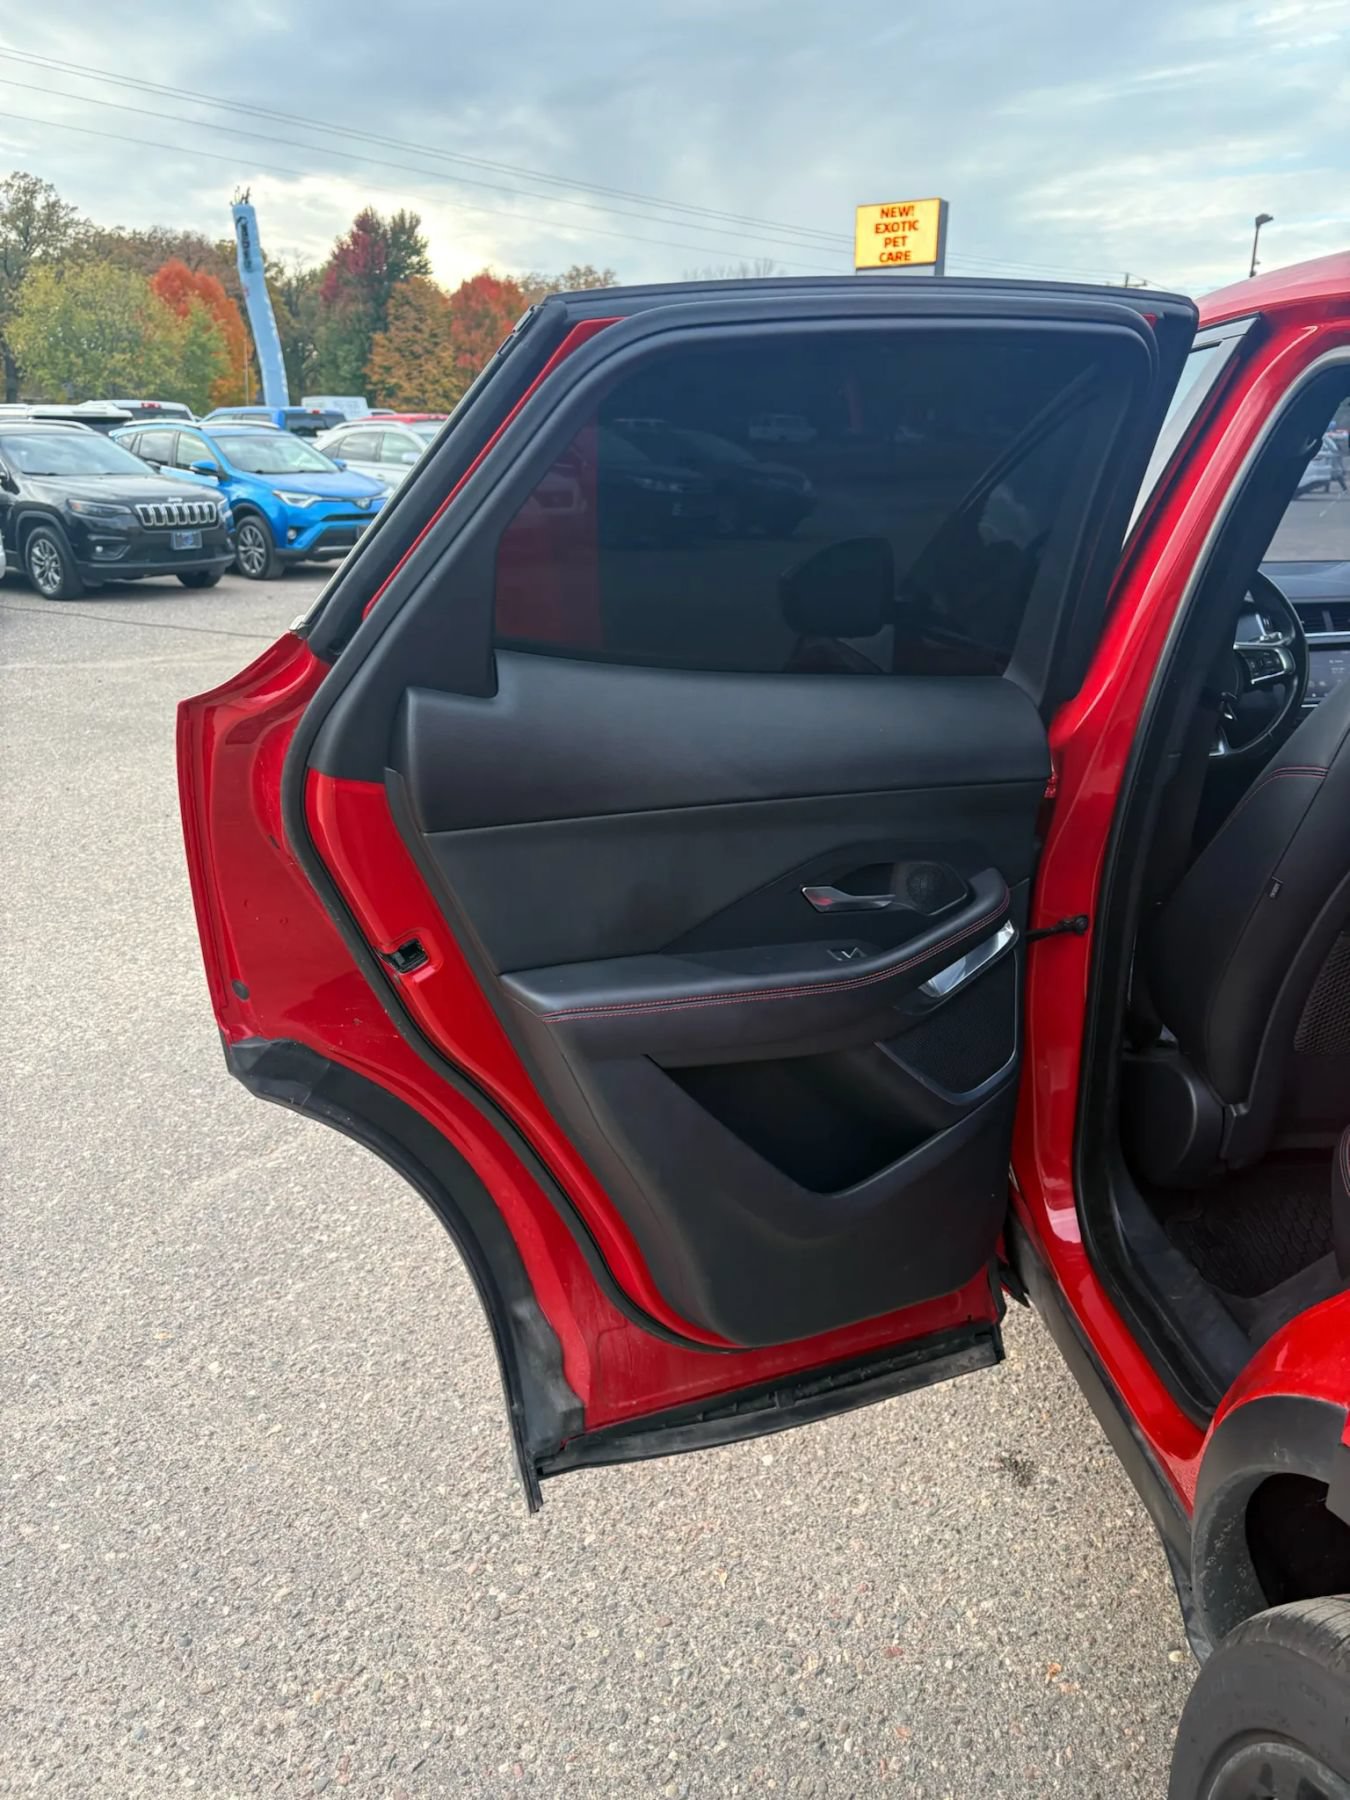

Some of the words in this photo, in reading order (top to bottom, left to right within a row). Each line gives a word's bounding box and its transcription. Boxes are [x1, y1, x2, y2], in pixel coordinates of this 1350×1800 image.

[874, 220, 919, 234] EXOTIC
[884, 235, 907, 248] PET
[879, 250, 911, 263] CARE
